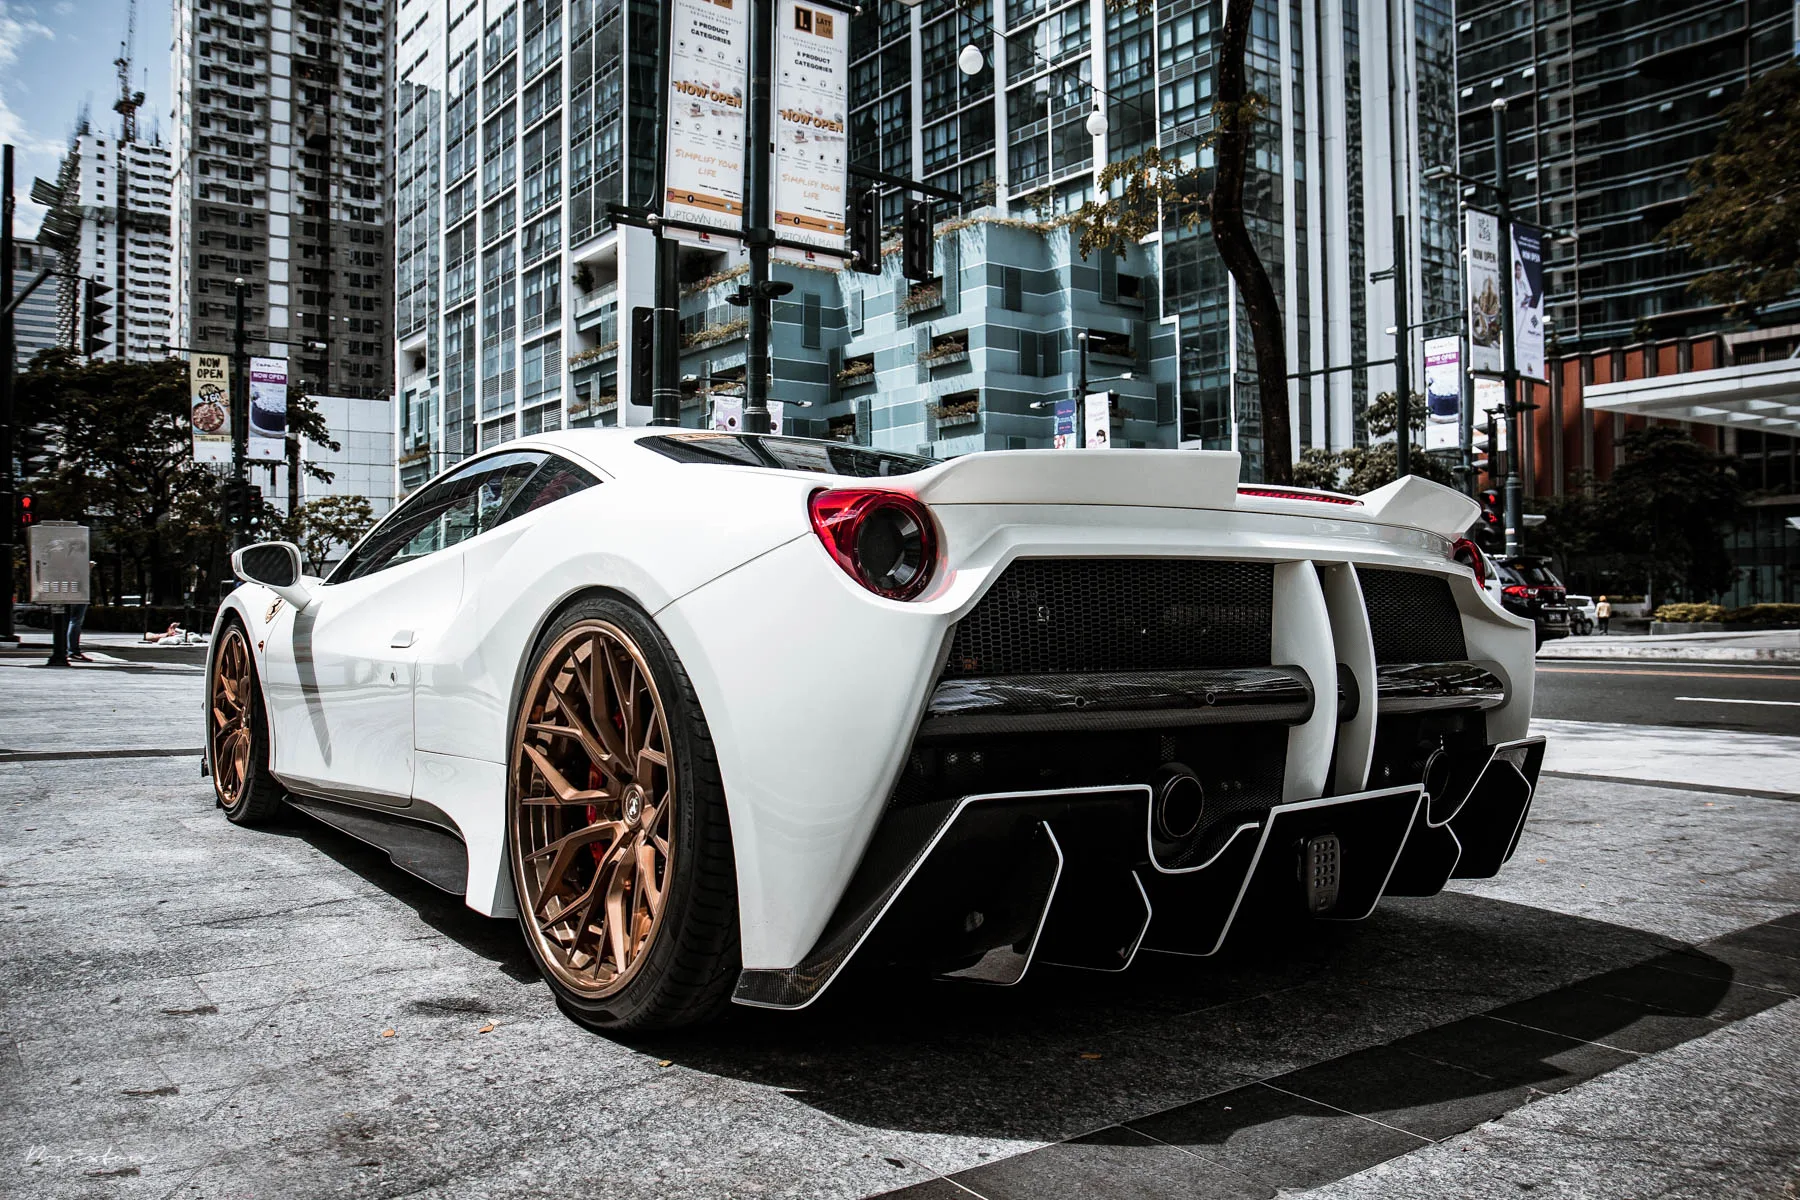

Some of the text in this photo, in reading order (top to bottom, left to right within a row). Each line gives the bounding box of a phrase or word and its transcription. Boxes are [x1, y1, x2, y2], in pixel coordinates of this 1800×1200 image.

[699, 21, 729, 36] PRODUCT
[690, 28, 732, 46] CATEGORIES
[801, 52, 831, 65] PRODUCT
[794, 59, 833, 73] CATEGORIES
[676, 80, 743, 109] NOW OPEN
[782, 108, 844, 134] NOW OPEN
[675, 147, 739, 172] SIMPLIFY YOUR
[698, 167, 717, 178] LIFE
[781, 172, 841, 193] SIMPLIFY YOUR
[803, 190, 821, 201] LIFE
[668, 208, 738, 230] UPTOWN MALL
[776, 231, 816, 245] UPTOWN
[199, 356, 221, 368] NOW
[1427, 355, 1441, 363] NOW
[1441, 352, 1457, 361] OPEN
[197, 368, 224, 379] OPEN
[268, 373, 285, 381] OPEN
